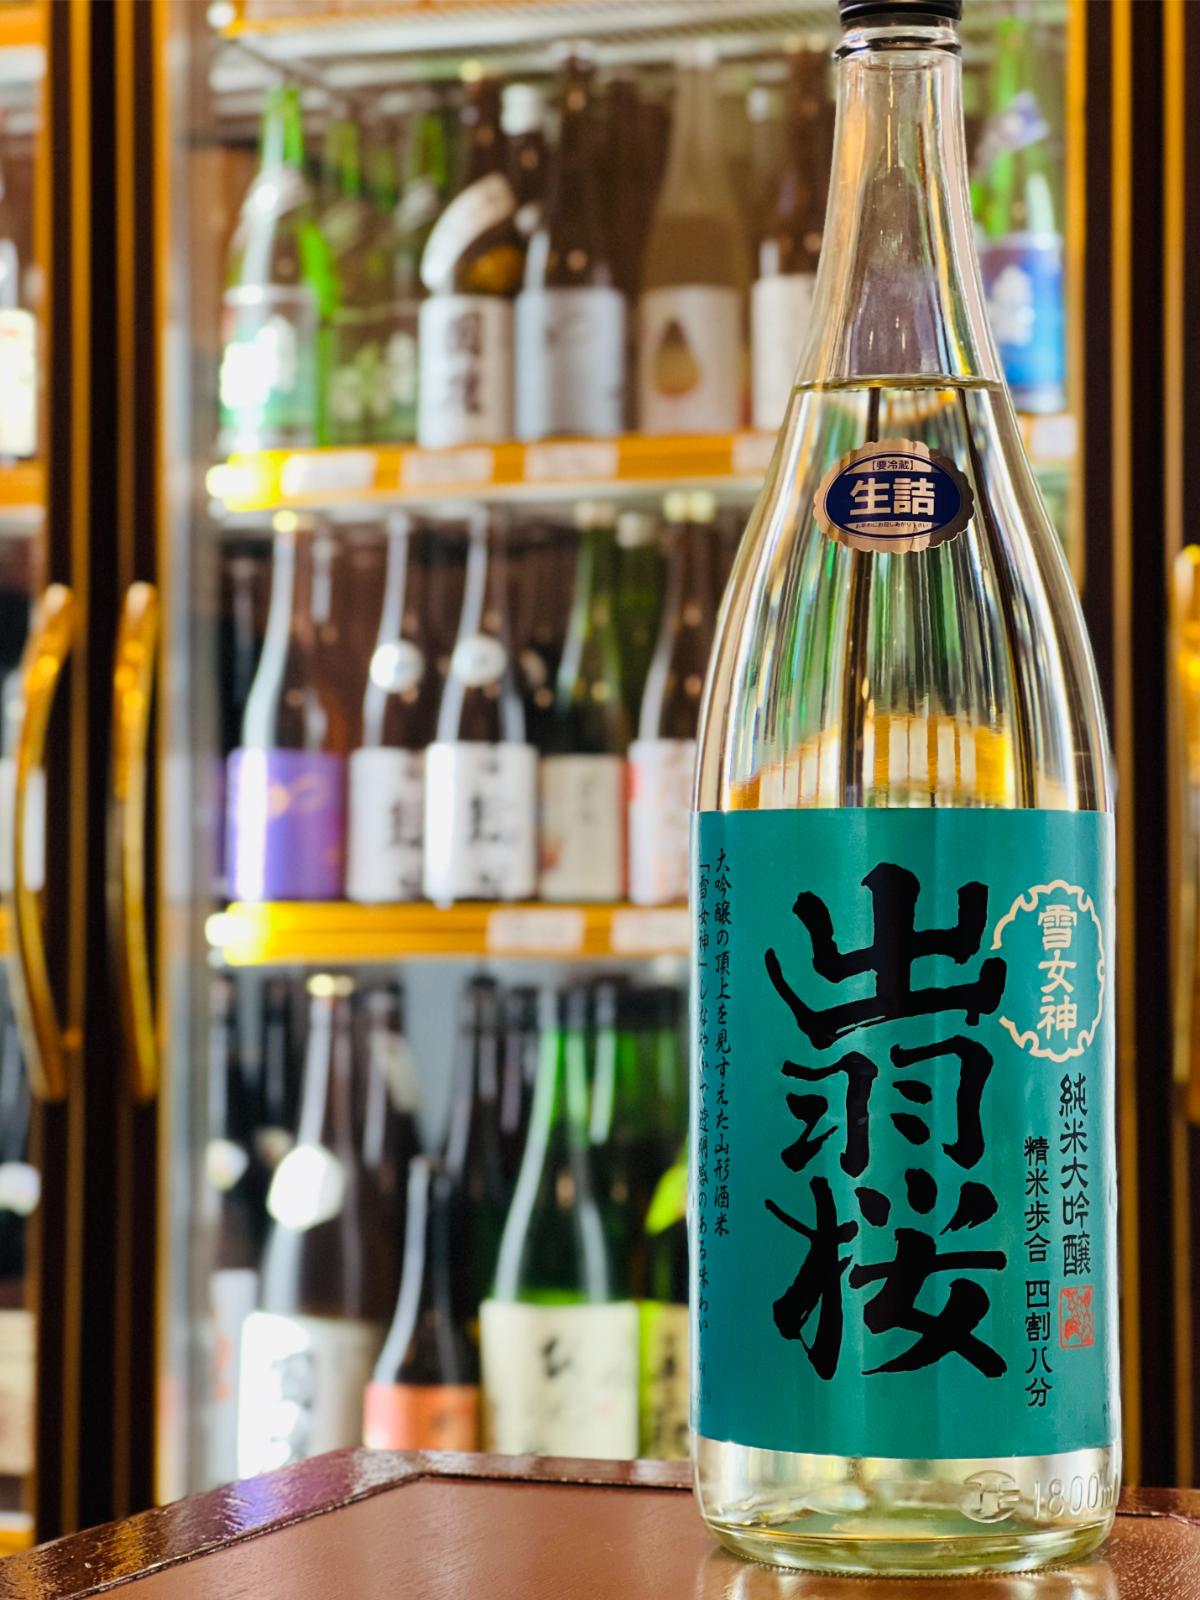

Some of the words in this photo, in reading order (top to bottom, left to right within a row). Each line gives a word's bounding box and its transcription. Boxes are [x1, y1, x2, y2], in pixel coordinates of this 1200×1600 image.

[849, 477, 936, 516] 生詰
[1037, 904, 1078, 1041] 雪女神
[764, 862, 1008, 1381] 出羽桜
[1059, 1072, 1091, 1277] 純米大吟醸
[1024, 1135, 1051, 1263] 精米歩合
[1025, 1280, 1053, 1408] 四割八分
